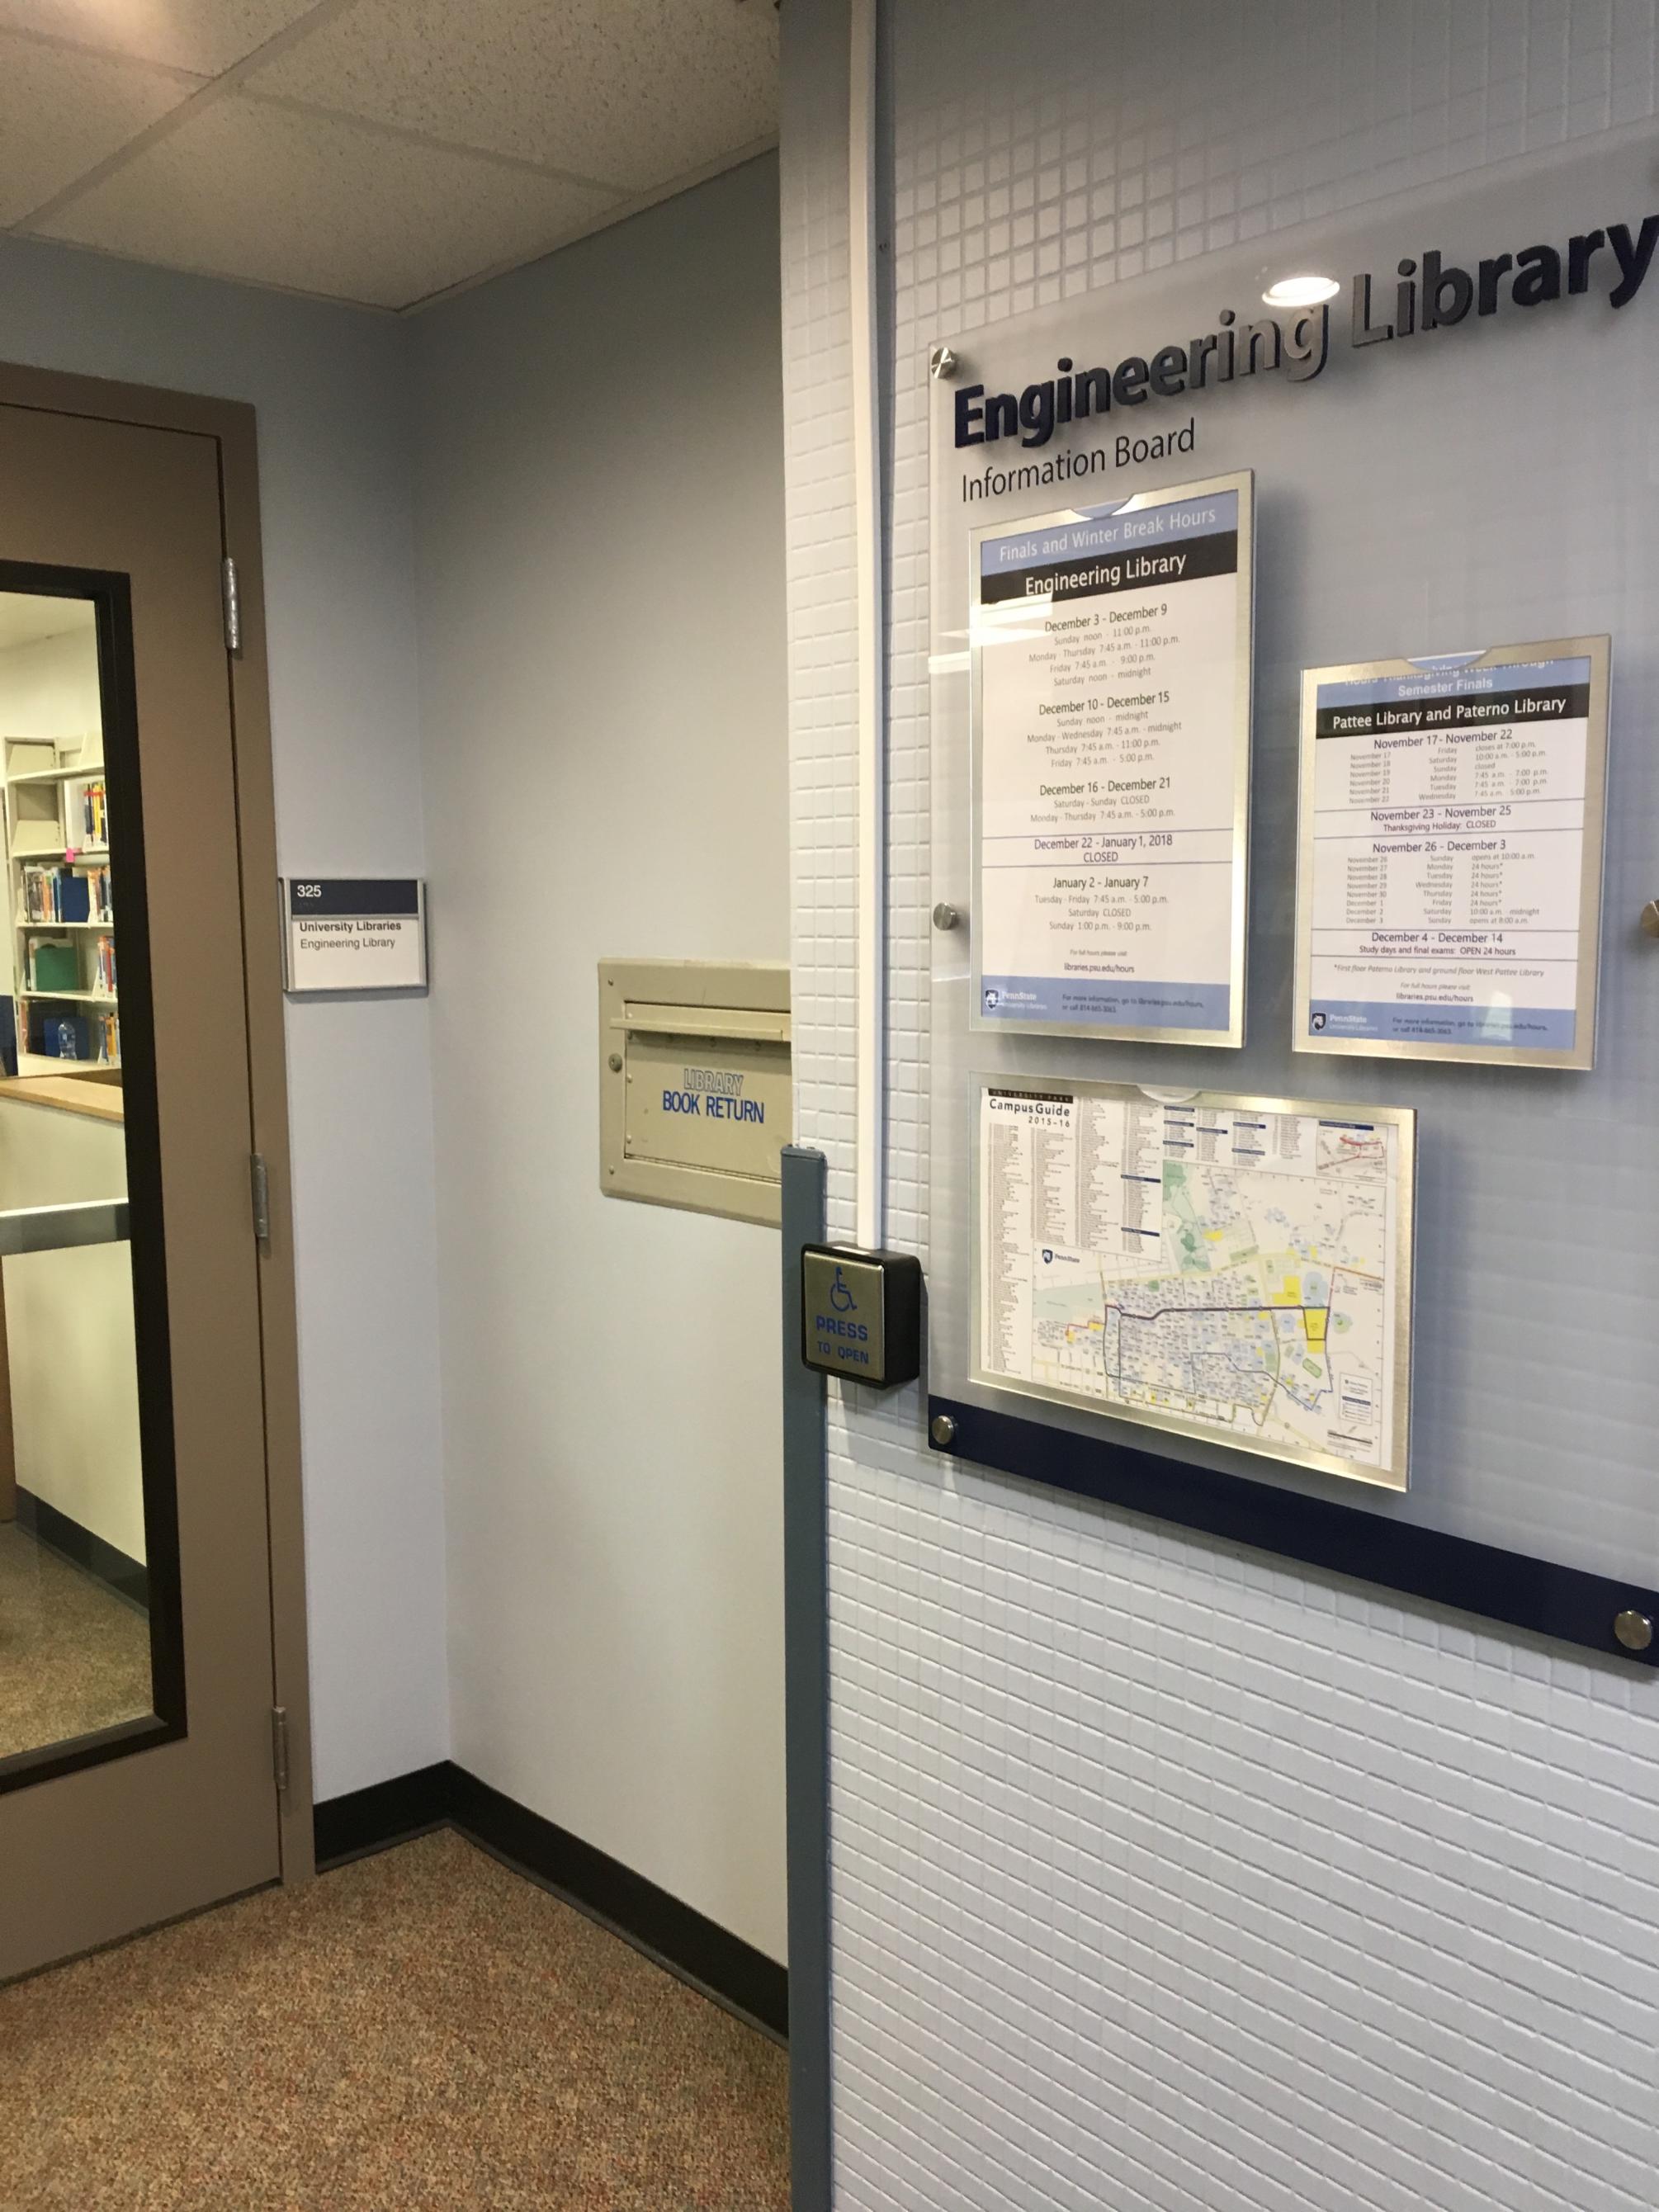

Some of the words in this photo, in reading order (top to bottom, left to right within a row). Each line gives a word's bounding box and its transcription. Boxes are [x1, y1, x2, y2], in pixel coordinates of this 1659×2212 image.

[955, 303, 1329, 448] Engineering
[1352, 215, 1659, 347] Library
[962, 449, 1105, 502] Information
[1116, 417, 1194, 467] Board
[1000, 541, 1037, 561] Finals
[1042, 532, 1068, 554] and
[1073, 527, 1118, 548] Winter
[1124, 515, 1164, 539] Break
[1170, 509, 1216, 529] Hours
[1026, 565, 1121, 595] Engineering
[1127, 555, 1186, 579] Library
[1045, 617, 1090, 632] December
[1094, 614, 1099, 625] 3
[1109, 607, 1158, 622] December
[1161, 603, 1167, 615] 9
[1054, 636, 1080, 645] Sunday
[1084, 632, 1102, 641] noon
[1029, 653, 1056, 663] Monday
[1063, 647, 1095, 658] Thursday
[1100, 643, 1114, 653] 7:45
[1141, 637, 1161, 648] 11:00
[1163, 636, 1180, 645] p.m.
[1050, 663, 1071, 674] Friday
[1075, 660, 1090, 669] 7:45
[1121, 655, 1137, 664] 9:00
[1139, 654, 1155, 663] p.m.
[1054, 674, 1085, 686] Saturday
[1089, 674, 1107, 682] noon
[1118, 667, 1151, 678] midnight
[1398, 680, 1453, 697] Semester
[1457, 677, 1492, 691] Finals
[1039, 702, 1085, 715] December
[1088, 699, 1098, 710] 10
[1108, 694, 1156, 708] December
[1159, 691, 1170, 702] 15
[1057, 717, 1082, 727] Sunday
[1116, 711, 1148, 721] midnight
[1333, 716, 1372, 730] Pattee
[1377, 711, 1422, 726] Library
[1426, 706, 1451, 721] and
[1457, 702, 1509, 718] Paterno
[1515, 698, 1566, 713] Library
[1028, 734, 1056, 743] Monday
[1062, 729, 1103, 740] Wednesday
[1107, 727, 1123, 735] 7:45
[1148, 722, 1181, 733] midnight
[1374, 737, 1423, 749] November
[1427, 735, 1438, 744] 17
[1446, 731, 1497, 743] November
[1501, 729, 1512, 740] 22
[1046, 744, 1078, 754] Thursday
[1081, 742, 1096, 752] 7:45
[1122, 739, 1141, 749] 11:00
[1144, 739, 1160, 748] p.m.
[1052, 759, 1072, 768] Friday
[1076, 756, 1091, 765] 7:45
[1094, 756, 1108, 764] a.m.
[1120, 754, 1136, 763] 5:00
[1040, 783, 1085, 796] December
[1088, 782, 1098, 792] 16
[1108, 779, 1156, 792] December
[1160, 777, 1170, 788] 21
[1054, 798, 1085, 808] Saturday
[1091, 796, 1117, 806] Sunday
[1121, 795, 1149, 805] CLOSED
[1031, 814, 1058, 823] Monday
[1065, 811, 1096, 821] Thursday
[1100, 811, 1115, 820] 7:45
[1118, 811, 1133, 819] a.m.
[1141, 809, 1157, 818] 5:00
[1159, 809, 1175, 818] p.m.
[1371, 810, 1420, 820] November
[1423, 809, 1434, 819] 23
[1445, 806, 1496, 818] November
[1500, 806, 1511, 815] 25
[1383, 824, 1430, 832] Thanksgiving
[1034, 839, 1079, 849] December
[1081, 838, 1092, 848] 22
[1102, 837, 1136, 849] January
[1139, 836, 1146, 848] 1,
[1149, 834, 1172, 846] 2018
[1373, 843, 1420, 853] November
[1425, 842, 1436, 851] 26
[1448, 840, 1496, 851] December
[1501, 839, 1505, 849] 3
[1084, 852, 1118, 863] CLOSED
[297, 885, 321, 897] 325
[1053, 877, 1086, 891] January
[1089, 877, 1094, 887] 2
[1104, 877, 1140, 891] January
[1143, 877, 1149, 887] 7
[1035, 895, 1062, 905] Tuesday
[1069, 895, 1089, 905] Friday
[1094, 895, 1109, 903] 7:45
[1111, 895, 1126, 903] a.m.
[1134, 895, 1150, 903] 5:00
[1152, 896, 1169, 904] p.m.
[1069, 909, 1099, 918] Saturday
[1104, 909, 1132, 917] CLOSED
[300, 923, 353, 933] University
[357, 922, 401, 931] Libraries
[1050, 921, 1074, 930] Sunday
[1078, 922, 1093, 930] 1:00
[1094, 922, 1110, 931] p.m.
[1118, 922, 1133, 930] 9:00
[1136, 922, 1151, 932] p.m.
[300, 939, 360, 950] Engineering
[363, 938, 395, 948] Library
[1372, 933, 1418, 943] December
[1421, 933, 1428, 943] 4
[1438, 933, 1487, 943] December
[1491, 933, 1503, 943] 14
[1381, 946, 1396, 954] days
[684, 1069, 744, 1096] LIBRARY
[663, 1090, 700, 1115] BOOK
[707, 1096, 764, 1123] RETURN
[816, 1315, 867, 1340] PRESS
[817, 1340, 830, 1354] TO
[839, 1346, 868, 1364] OPEN
